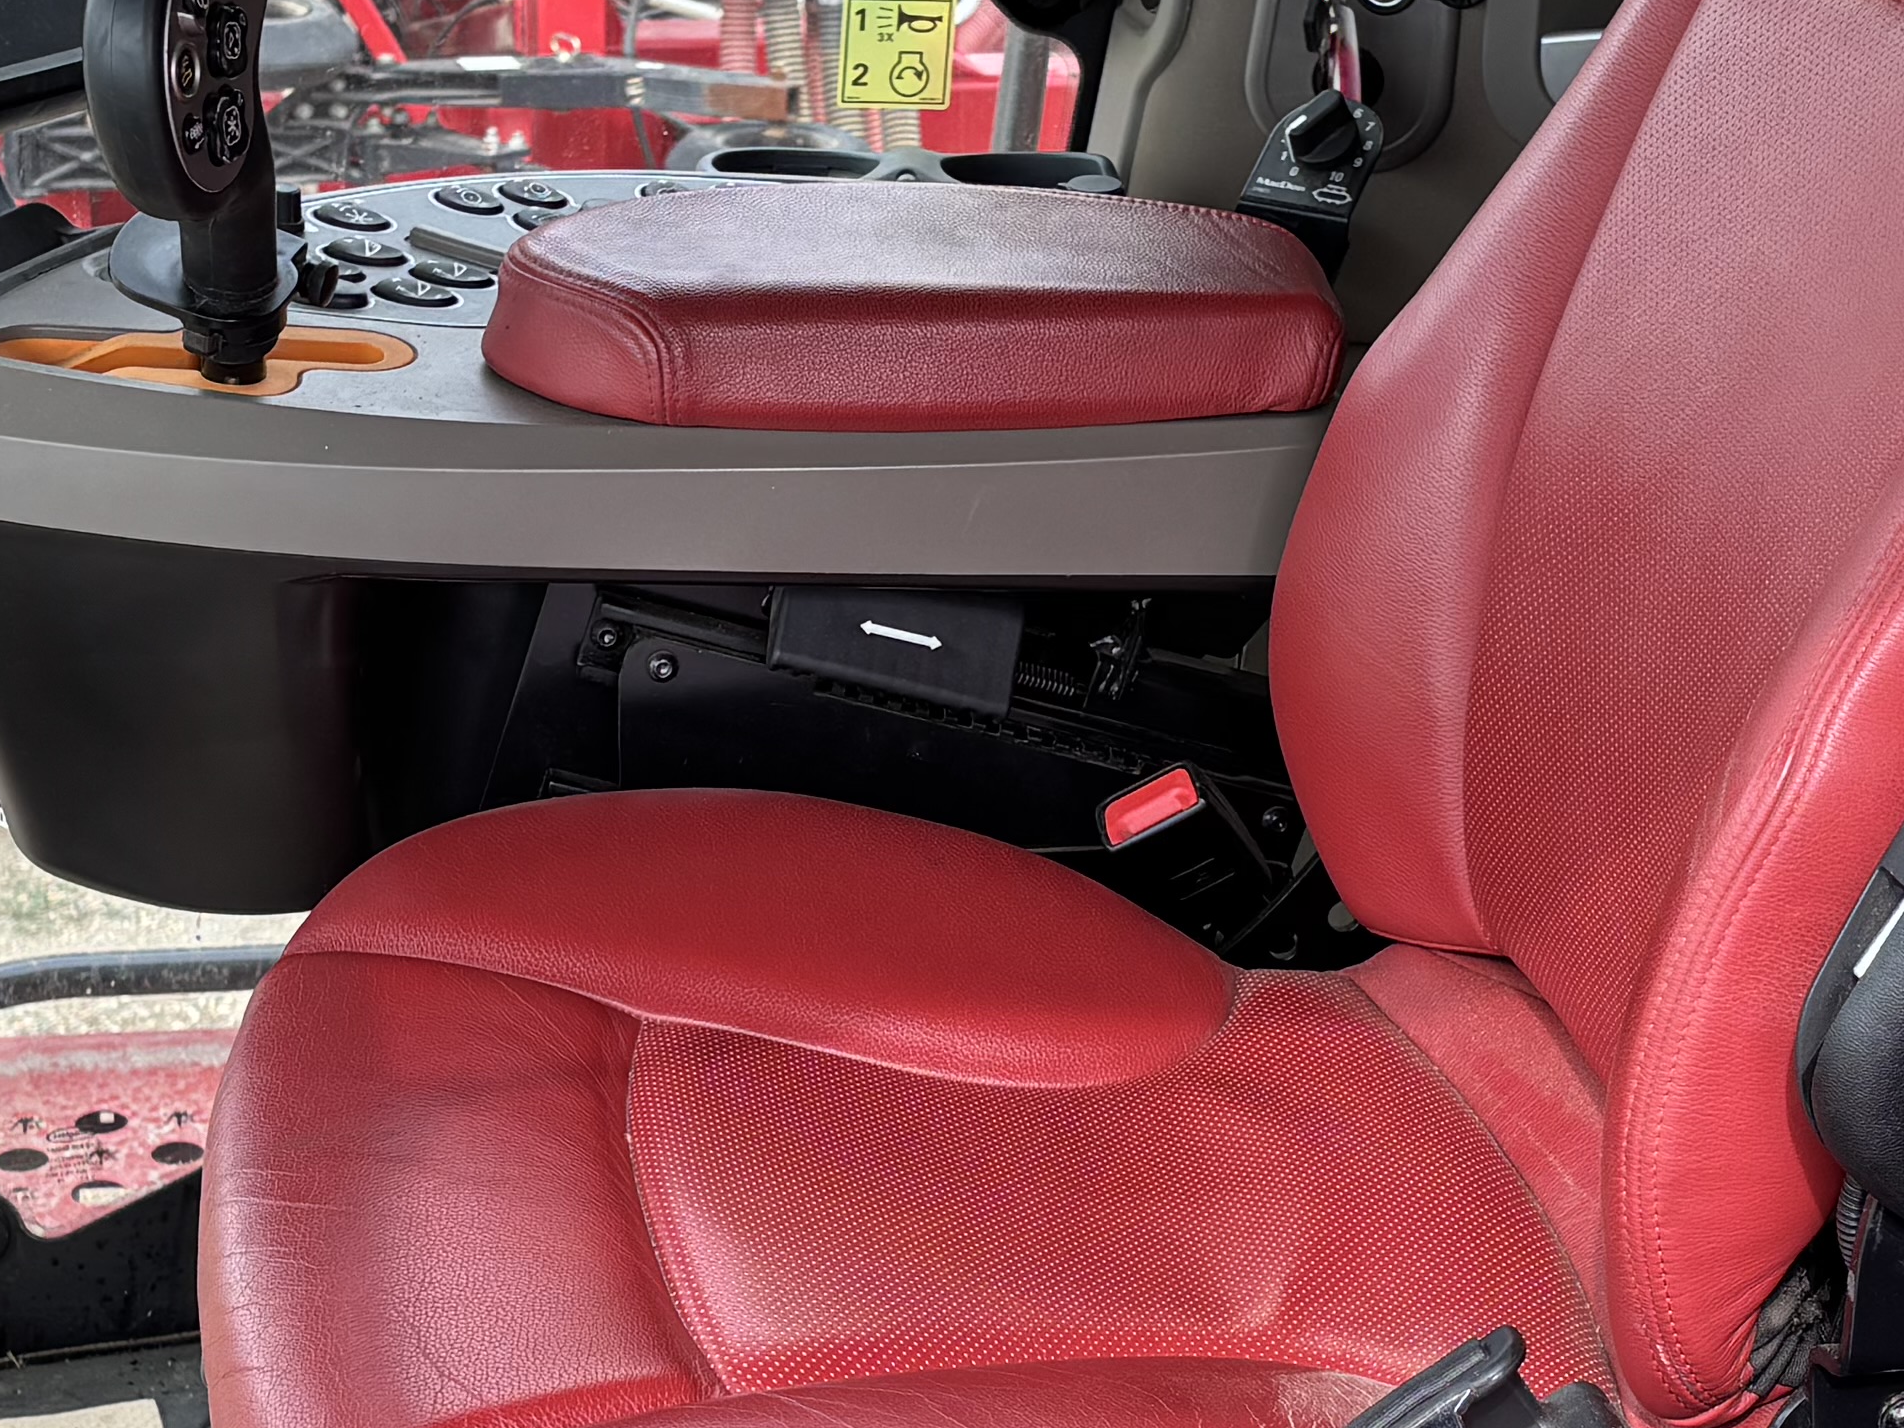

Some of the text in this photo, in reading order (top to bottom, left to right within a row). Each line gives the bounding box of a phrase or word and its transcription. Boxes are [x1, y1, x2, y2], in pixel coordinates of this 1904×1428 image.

[854, 8, 867, 31] 1
[876, 32, 894, 43] 3X
[851, 63, 869, 87] 2
[1364, 121, 1376, 132] 7
[1362, 140, 1374, 151] 8
[1352, 157, 1364, 168] 9
[1329, 171, 1345, 182] 10
